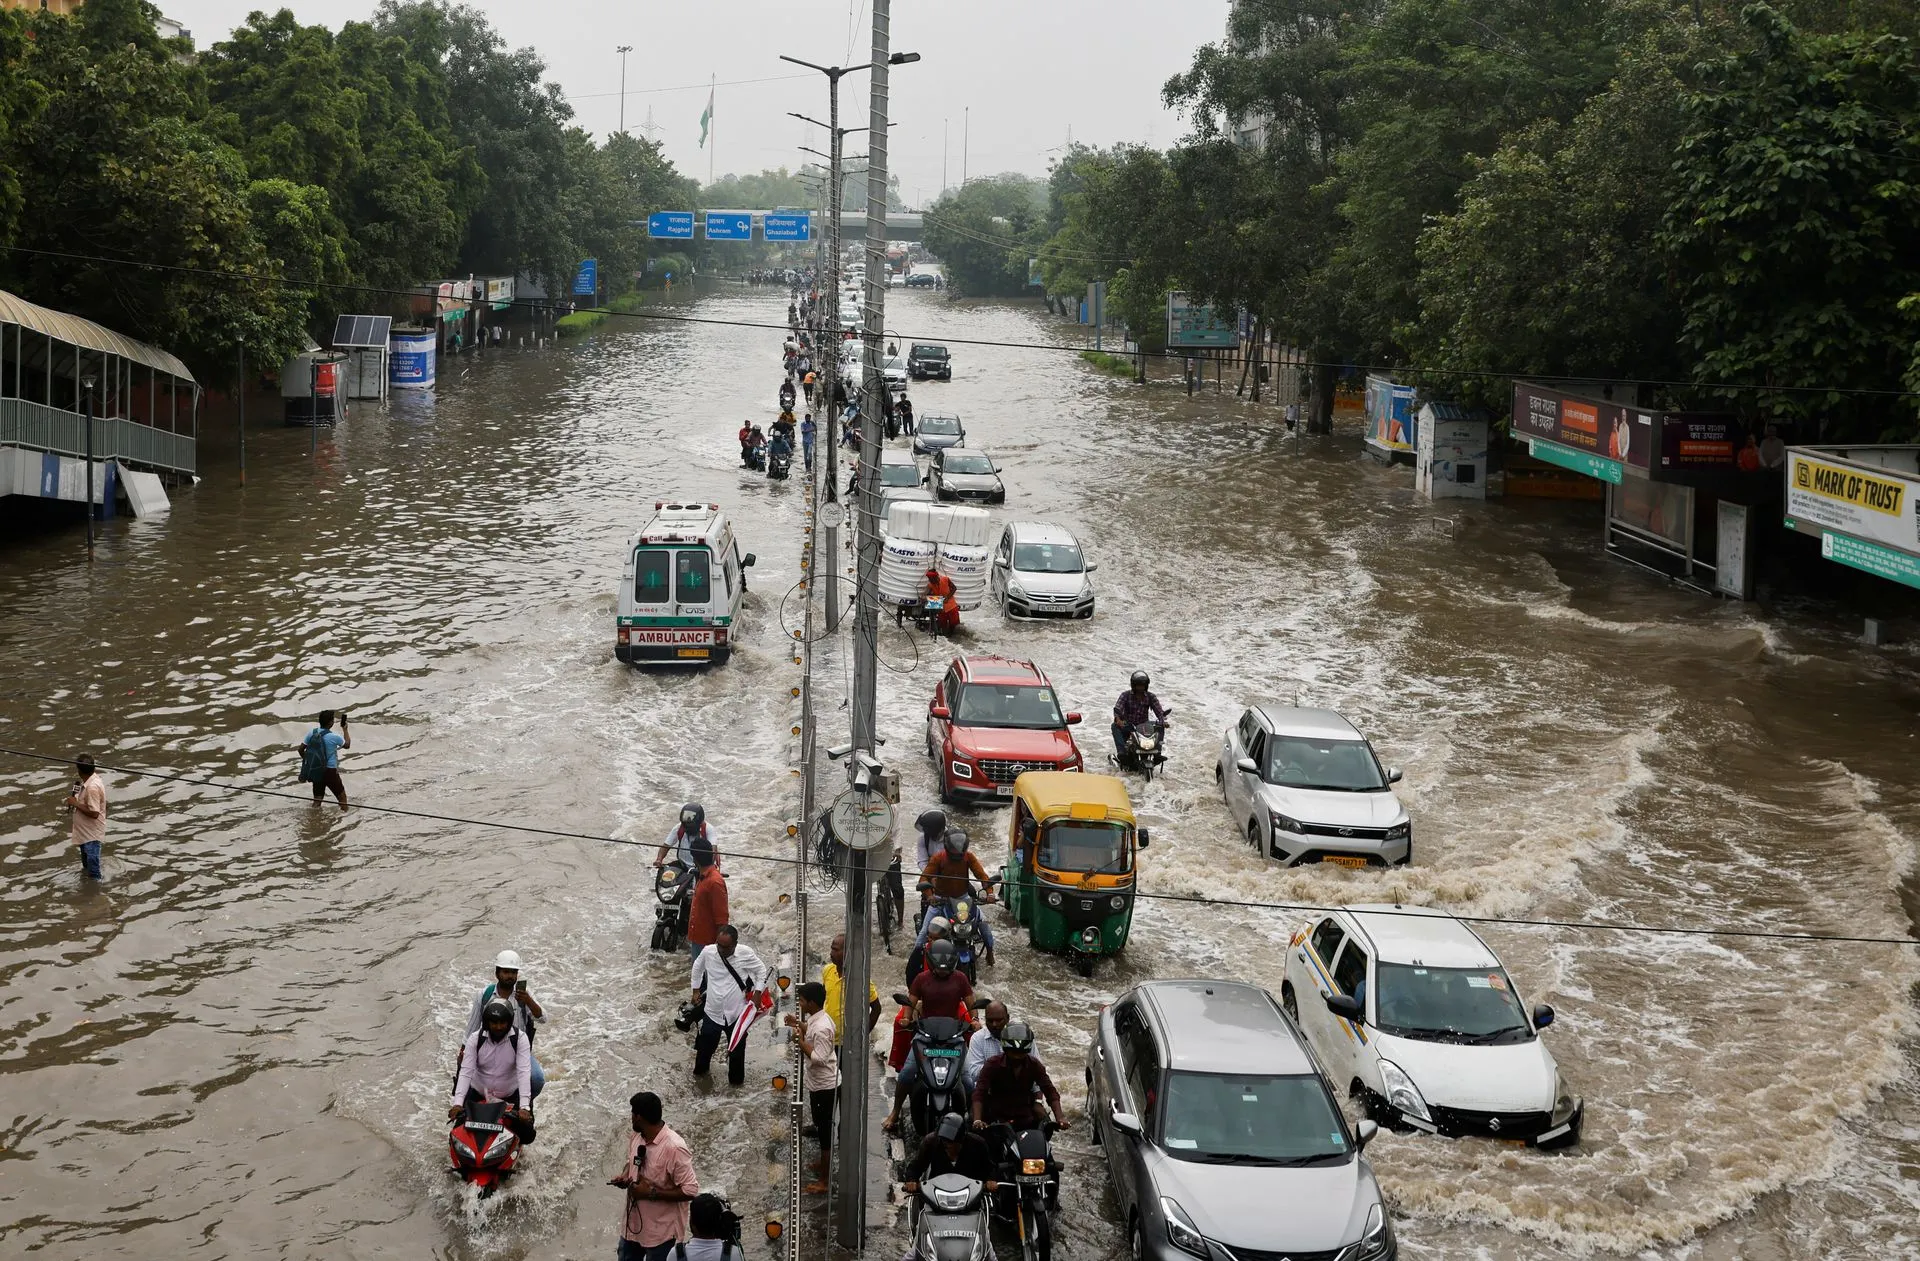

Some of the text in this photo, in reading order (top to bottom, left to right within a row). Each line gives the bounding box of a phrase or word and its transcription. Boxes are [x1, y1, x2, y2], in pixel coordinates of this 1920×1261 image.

[667, 226, 690, 234] Rajghat
[1814, 468, 1846, 497] MARK
[1847, 476, 1863, 501] OF
[1864, 480, 1901, 511] TRUST
[890, 547, 915, 556] PLASTO
[942, 552, 968, 562] PLASTO
